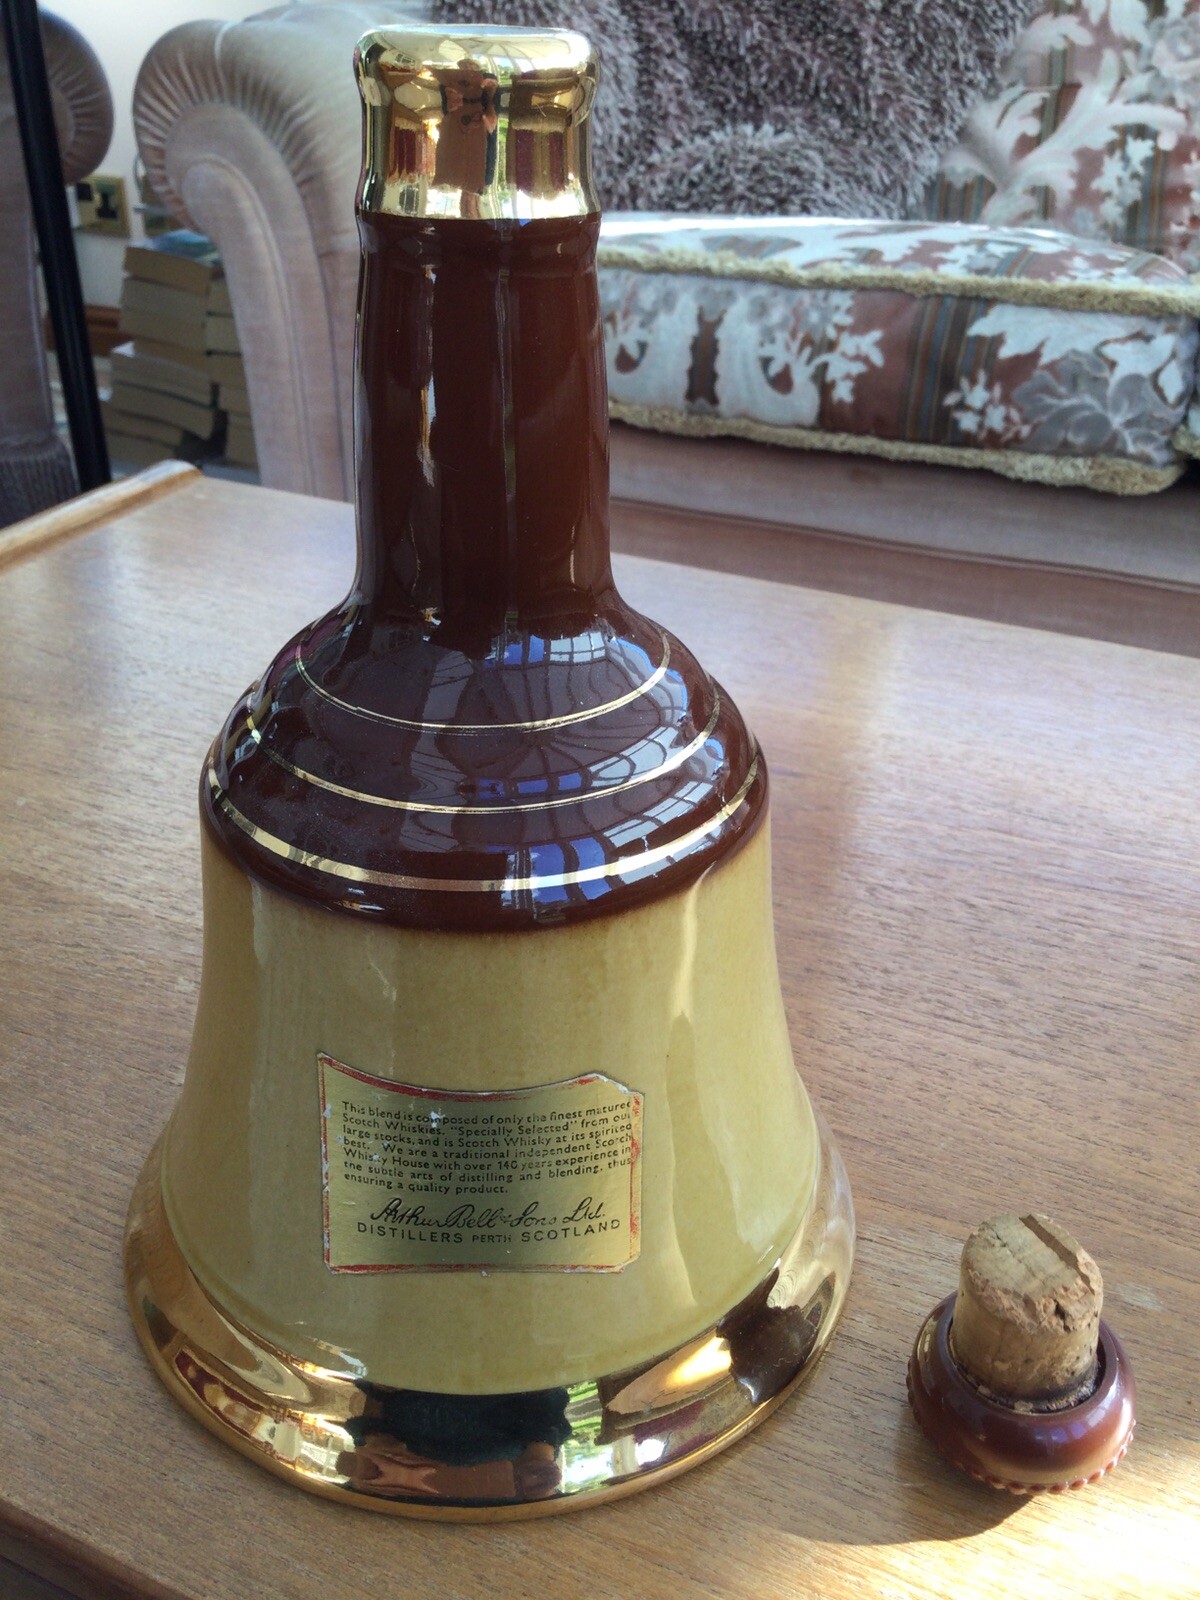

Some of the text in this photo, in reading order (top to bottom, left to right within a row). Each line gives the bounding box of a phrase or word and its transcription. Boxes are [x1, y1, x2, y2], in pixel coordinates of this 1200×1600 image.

[342, 1101, 365, 1114] This
[368, 1107, 401, 1120] blend
[403, 1112, 413, 1121] is
[482, 1115, 494, 1124] of
[497, 1115, 524, 1125] only
[526, 1113, 547, 1123] the
[550, 1111, 582, 1121] finest
[343, 1113, 380, 1128] Scotch
[385, 1120, 445, 1135] Whiskies.
[581, 1118, 609, 1128] from
[343, 1123, 632, 1148] large stocks, and is Scotch Whisky at its spirited
[343, 1136, 370, 1150] best.
[382, 1142, 403, 1154] We
[408, 1147, 430, 1157] are
[432, 1150, 438, 1158] a
[443, 1149, 509, 1159] traditional
[515, 1143, 591, 1160] independent
[344, 1160, 362, 1172] the
[368, 1165, 404, 1178] subtle
[410, 1170, 433, 1180] arts
[440, 1172, 452, 1181] of
[458, 1172, 513, 1183] distilling
[519, 1170, 541, 1181] and
[607, 1157, 632, 1169] thus
[392, 1156, 430, 1169] House
[433, 1160, 461, 1170] with
[464, 1162, 491, 1171] over
[498, 1160, 518, 1170] 140
[521, 1160, 553, 1171] years
[556, 1149, 619, 1167] experience
[621, 1146, 631, 1155] in
[344, 1172, 393, 1190] ensuring
[408, 1181, 450, 1195] quality
[455, 1184, 508, 1195] product.
[370, 1197, 446, 1227] Arthur
[357, 1219, 620, 1244] DISTILLERS PERTH SCOTLAND
